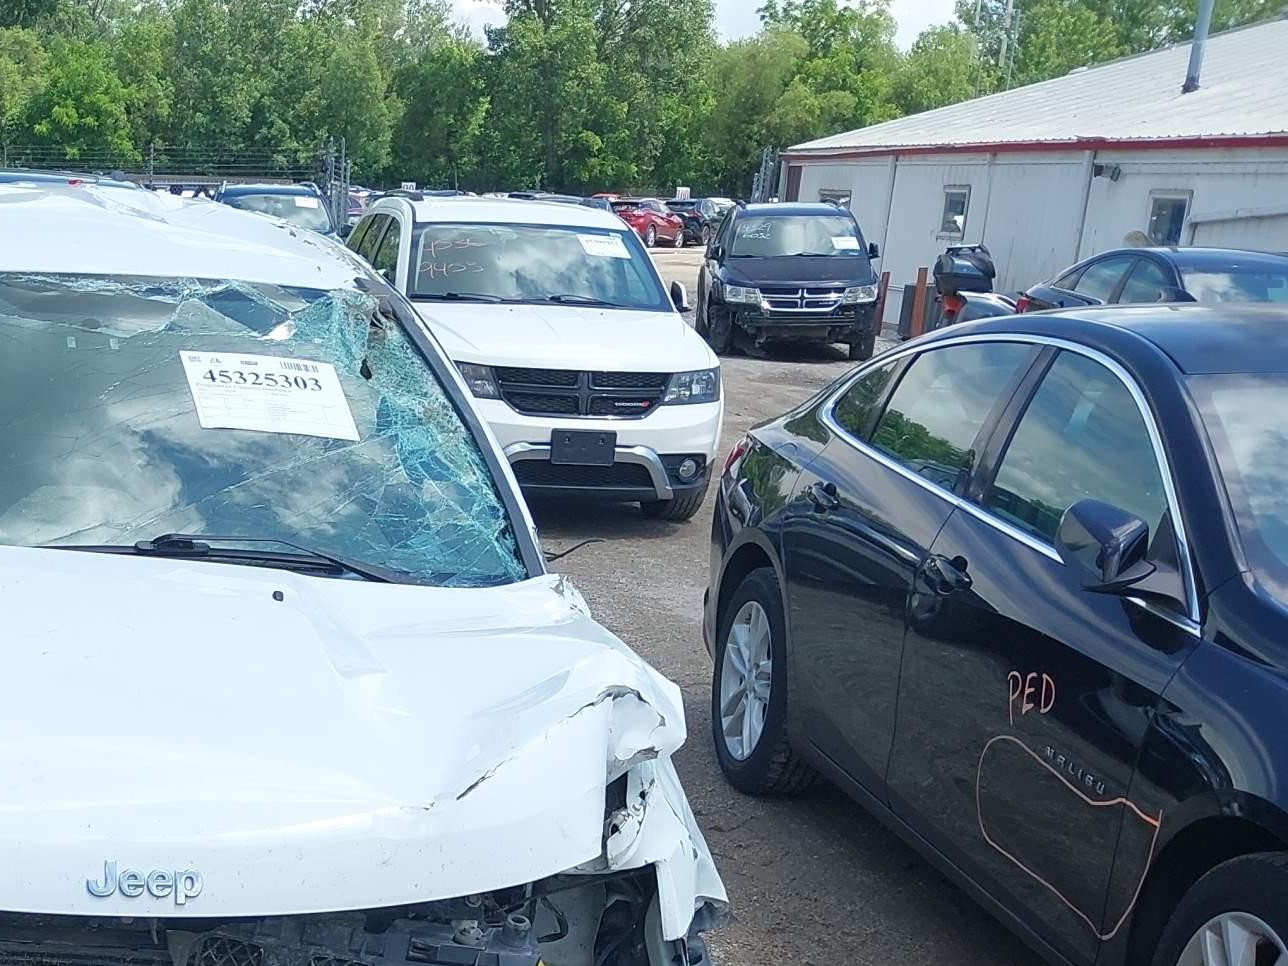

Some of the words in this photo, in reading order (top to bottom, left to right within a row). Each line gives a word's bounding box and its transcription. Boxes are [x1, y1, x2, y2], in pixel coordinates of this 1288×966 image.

[202, 368, 324, 392] 45325303
[1007, 670, 1056, 726] PED
[1046, 745, 1105, 795] MALIBU
[86, 859, 201, 907] Jeep
